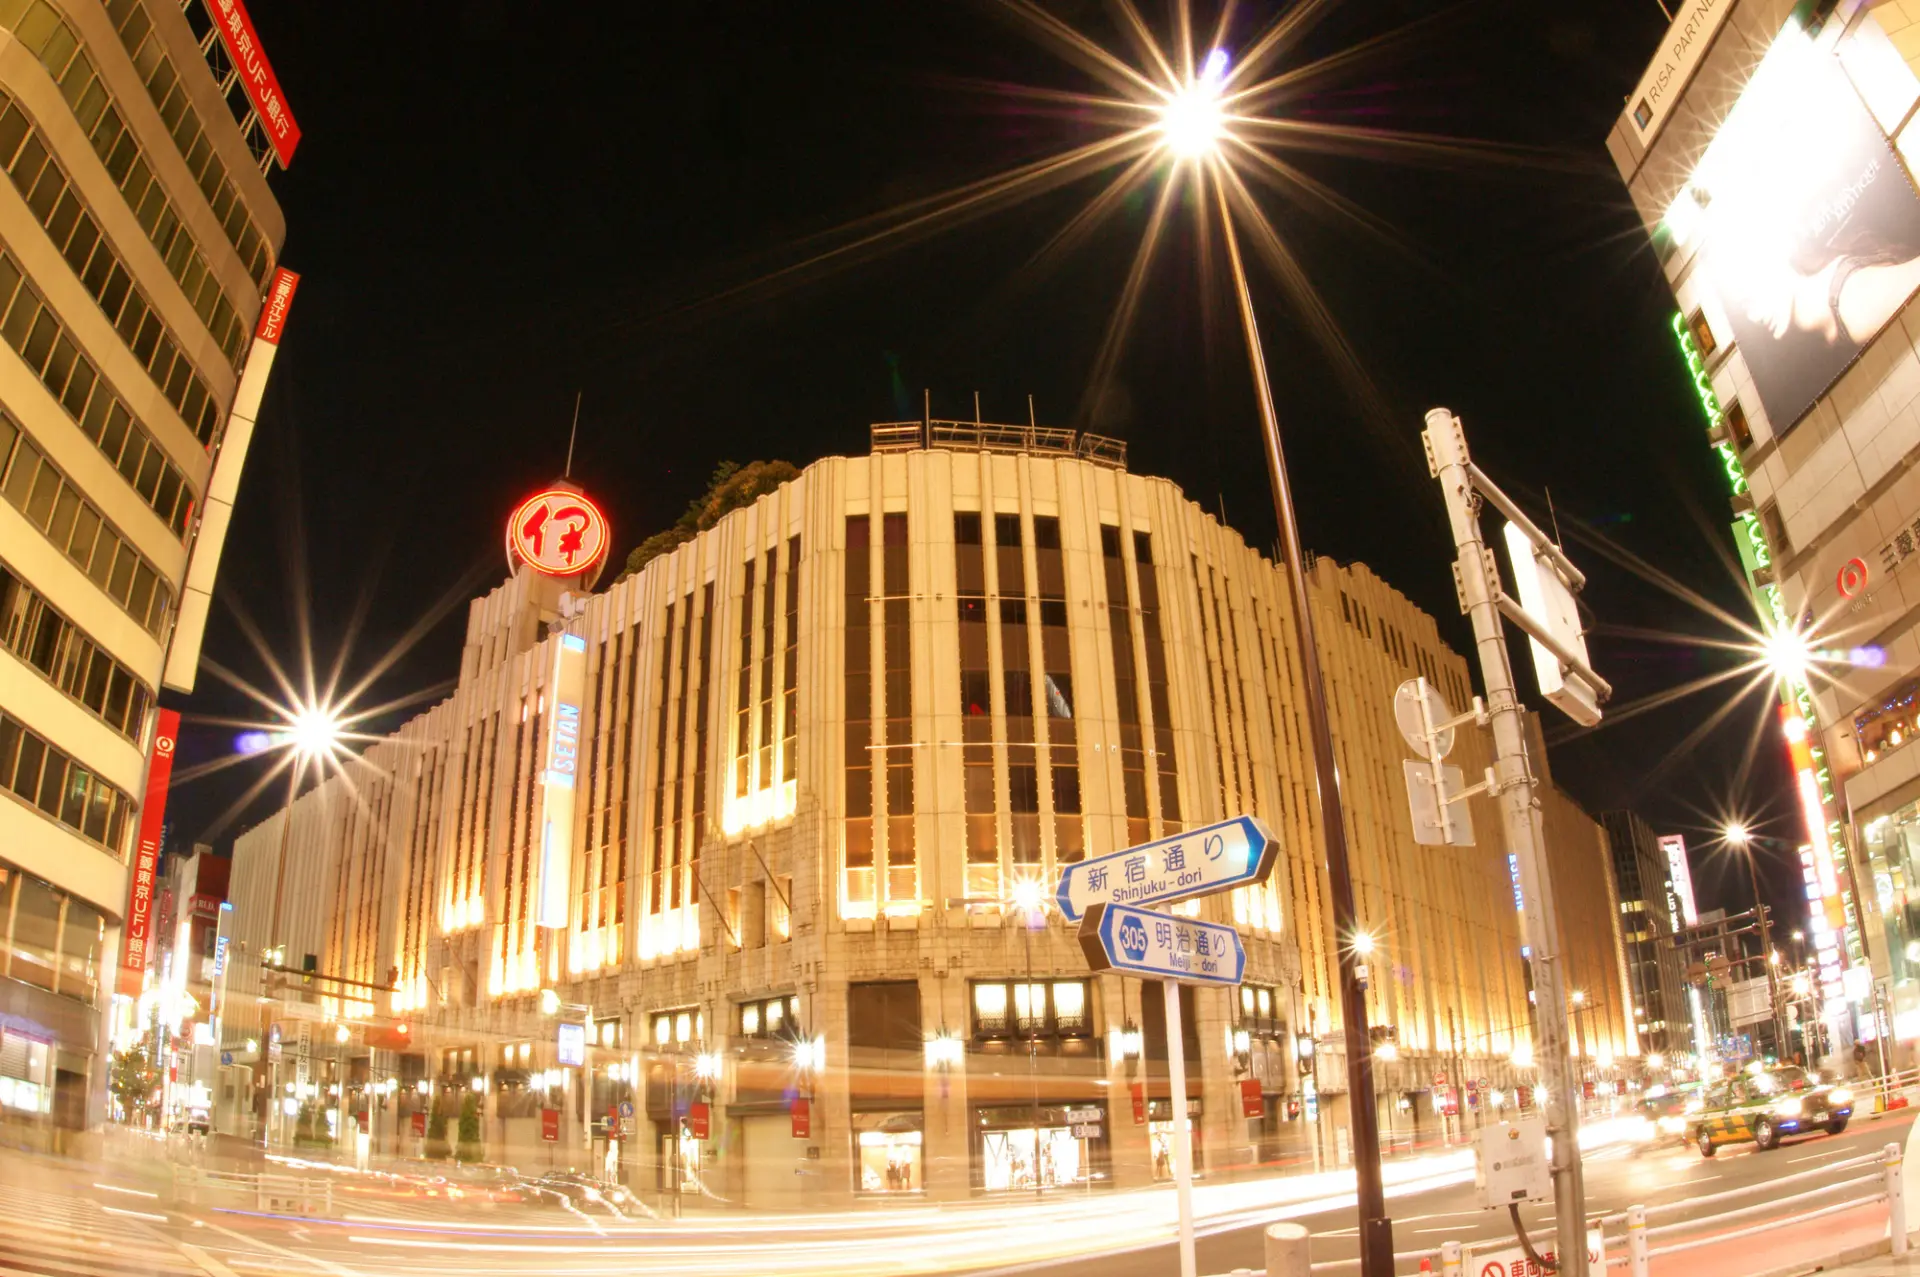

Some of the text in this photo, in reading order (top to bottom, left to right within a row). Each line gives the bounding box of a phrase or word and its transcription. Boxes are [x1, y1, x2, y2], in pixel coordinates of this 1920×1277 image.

[1649, 63, 1676, 104] RISA
[1879, 516, 1920, 573] 三菱
[1088, 834, 1223, 892] 新宿通り
[128, 840, 155, 968] 三菱東京UFJ銀行
[1121, 925, 1146, 952] 305
[1156, 922, 1226, 957] 明治通り
